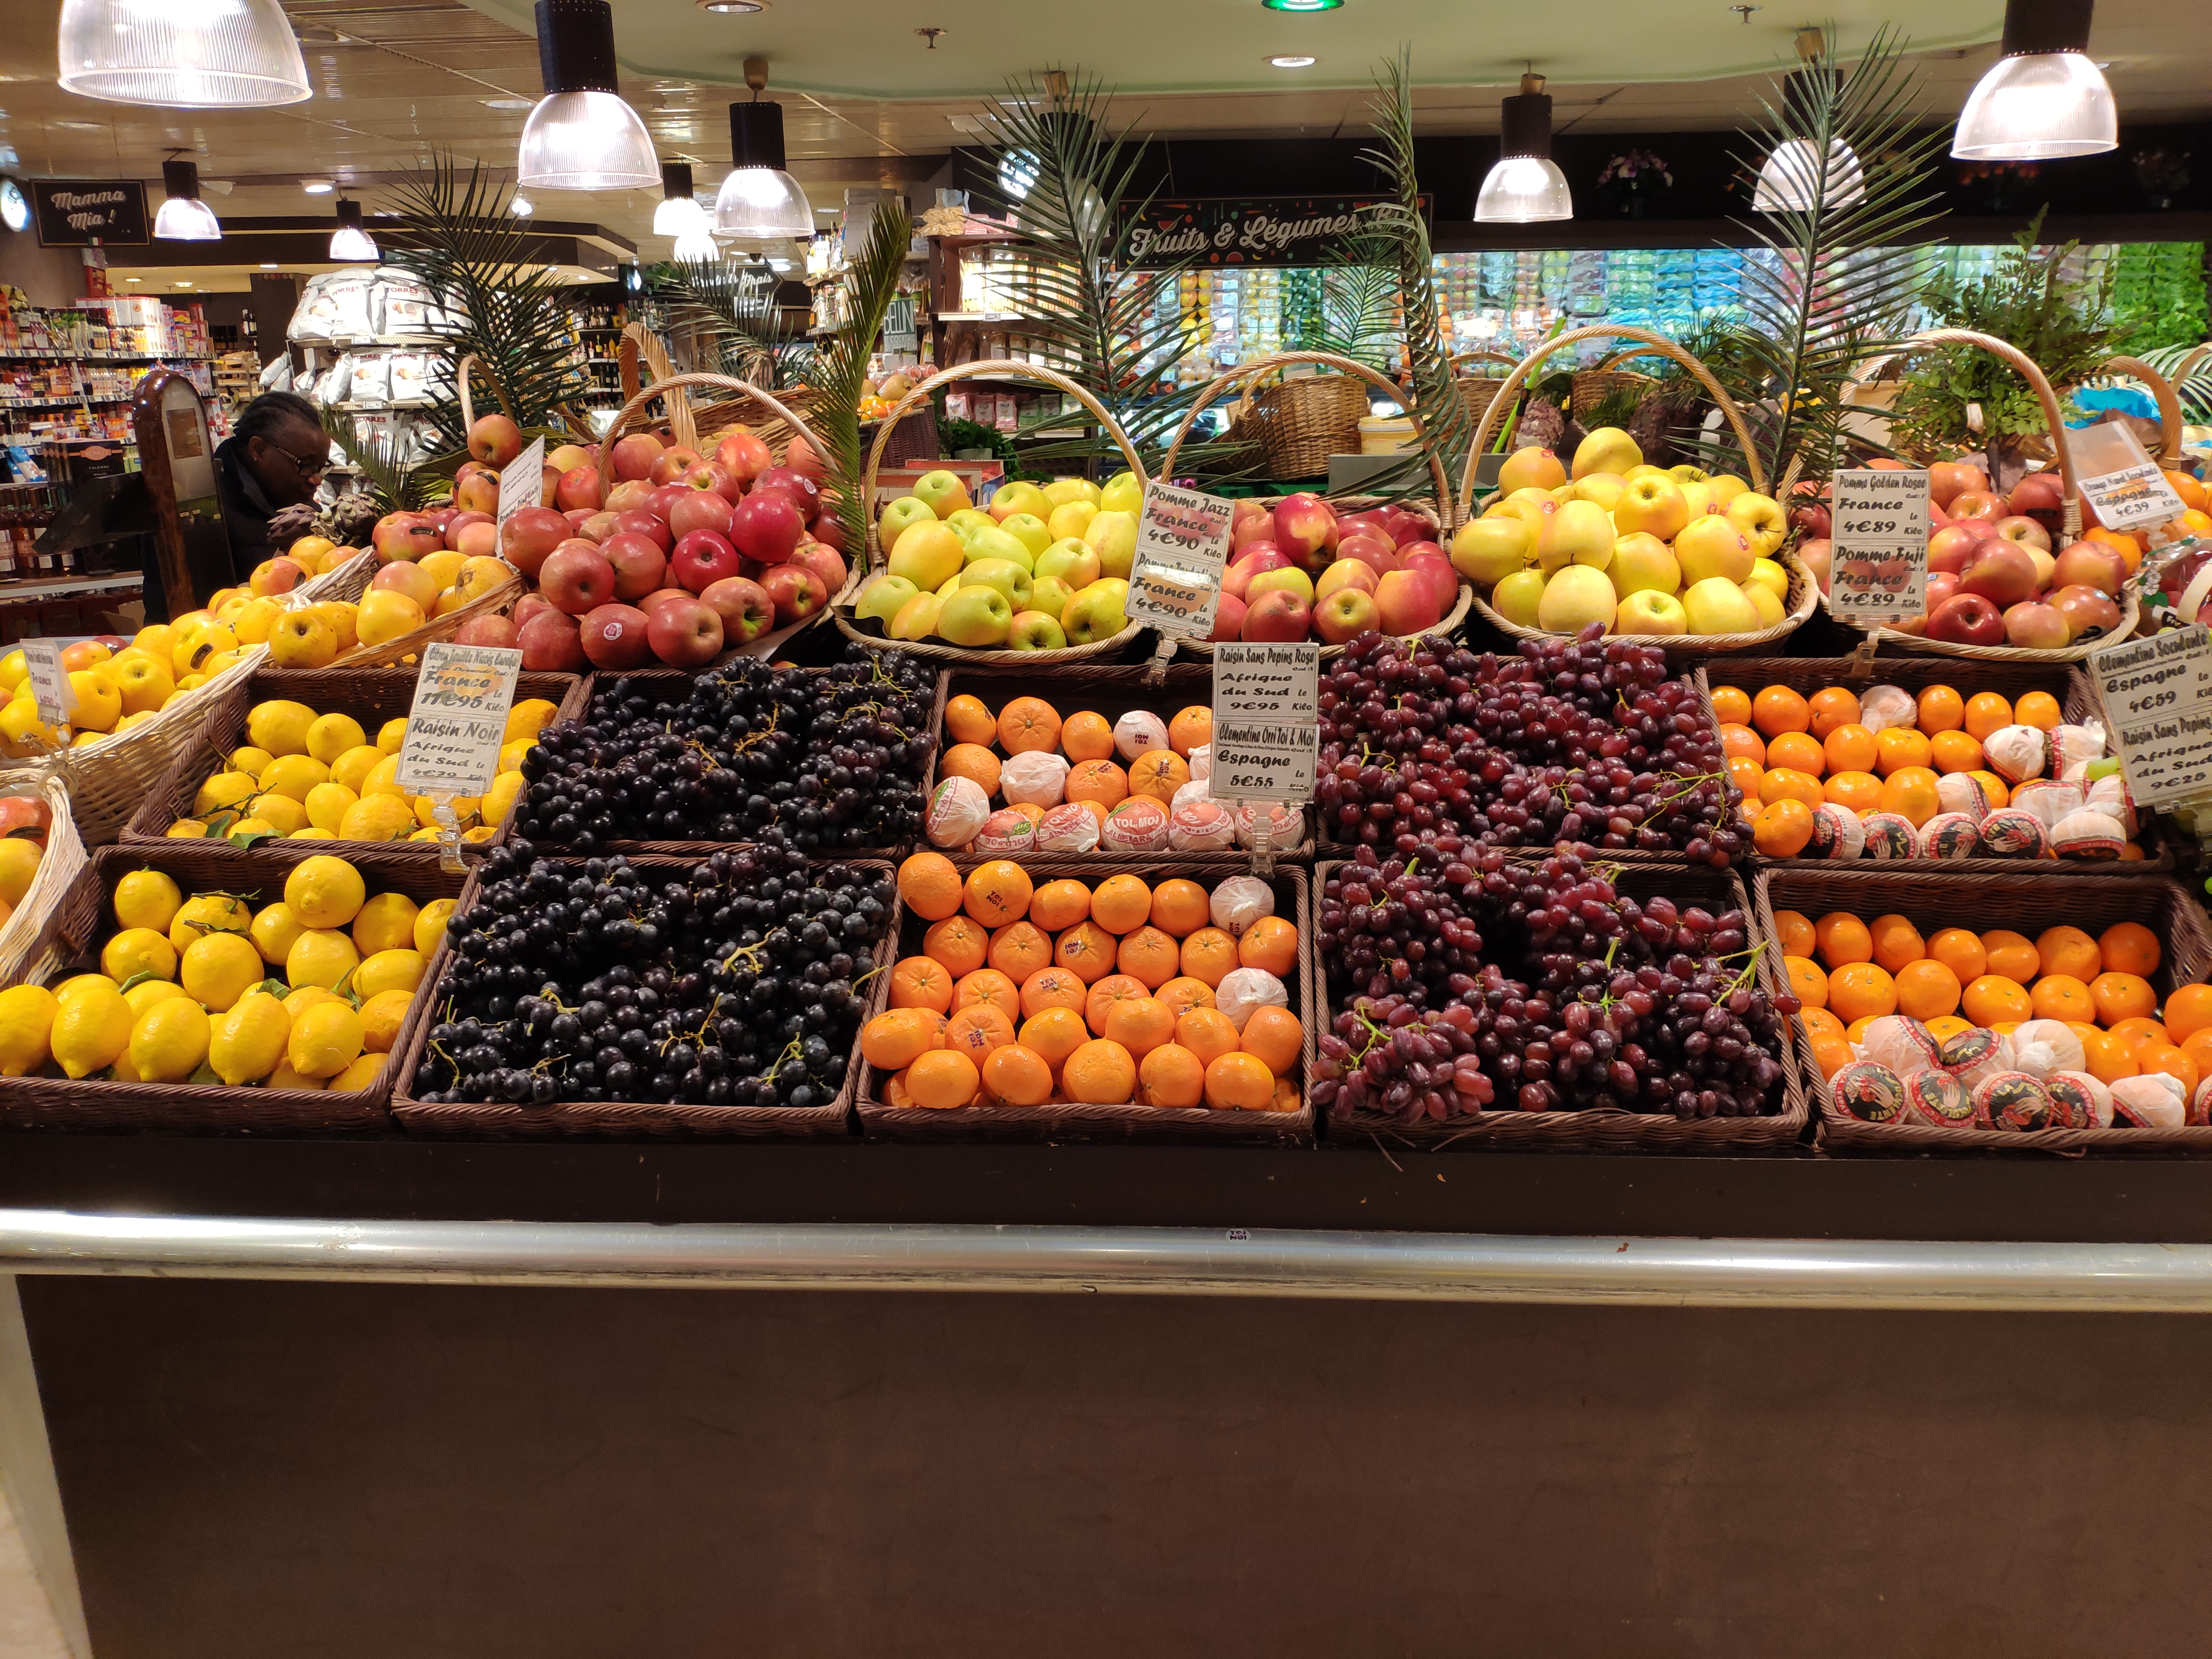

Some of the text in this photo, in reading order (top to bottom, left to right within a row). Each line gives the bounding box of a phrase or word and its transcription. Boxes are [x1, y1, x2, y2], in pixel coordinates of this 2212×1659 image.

[50, 191, 127, 211] Mamma
[67, 212, 105, 232] Mia
[1129, 225, 1210, 258] Fruits
[1214, 222, 1238, 251] &
[1239, 212, 1363, 251] Légumes
[1838, 475, 1868, 490] Pomme
[1870, 475, 1900, 492] Golden
[1149, 486, 1231, 517] Pomme Jazz
[1838, 498, 1904, 510] France
[2116, 501, 2149, 516] 4€39
[1146, 507, 1208, 532] France
[1844, 521, 1897, 533] 4€89
[1148, 528, 1200, 550] 4€90
[1904, 527, 1923, 535] Kilo
[1203, 548, 1222, 559] Kilo
[1835, 546, 1924, 565] Pomme Fuji
[1835, 571, 1903, 585] France
[1133, 576, 1197, 601] France
[1136, 597, 1188, 618] 4€90
[1841, 592, 1895, 607] 4€89
[1218, 648, 1314, 667] Raisin Sans Pepins Rose
[423, 670, 490, 688] France
[1220, 673, 1293, 682] Afrique
[2106, 664, 2187, 693] Espagne
[1222, 687, 1246, 696] du
[1252, 687, 1290, 696] Sud
[420, 692, 483, 708] 11€95
[484, 702, 504, 712] Kilo
[1230, 702, 1312, 711] 9€95 Kilo
[2130, 690, 2176, 713] 4€59
[413, 718, 499, 740] Raisin Noir
[1219, 723, 1260, 743] Clementine
[1296, 729, 1314, 747] Moi
[2122, 726, 2154, 747] Raisin
[2154, 724, 2179, 739] Sans
[408, 741, 475, 753] Afrique
[407, 754, 430, 763] du
[435, 757, 470, 767] Sud
[1217, 749, 1291, 769] Espagne
[1230, 775, 1274, 788] 5€55
[1295, 770, 1305, 778] Le
[986, 895, 1000, 907] MOI
[991, 890, 1003, 902] TOI
